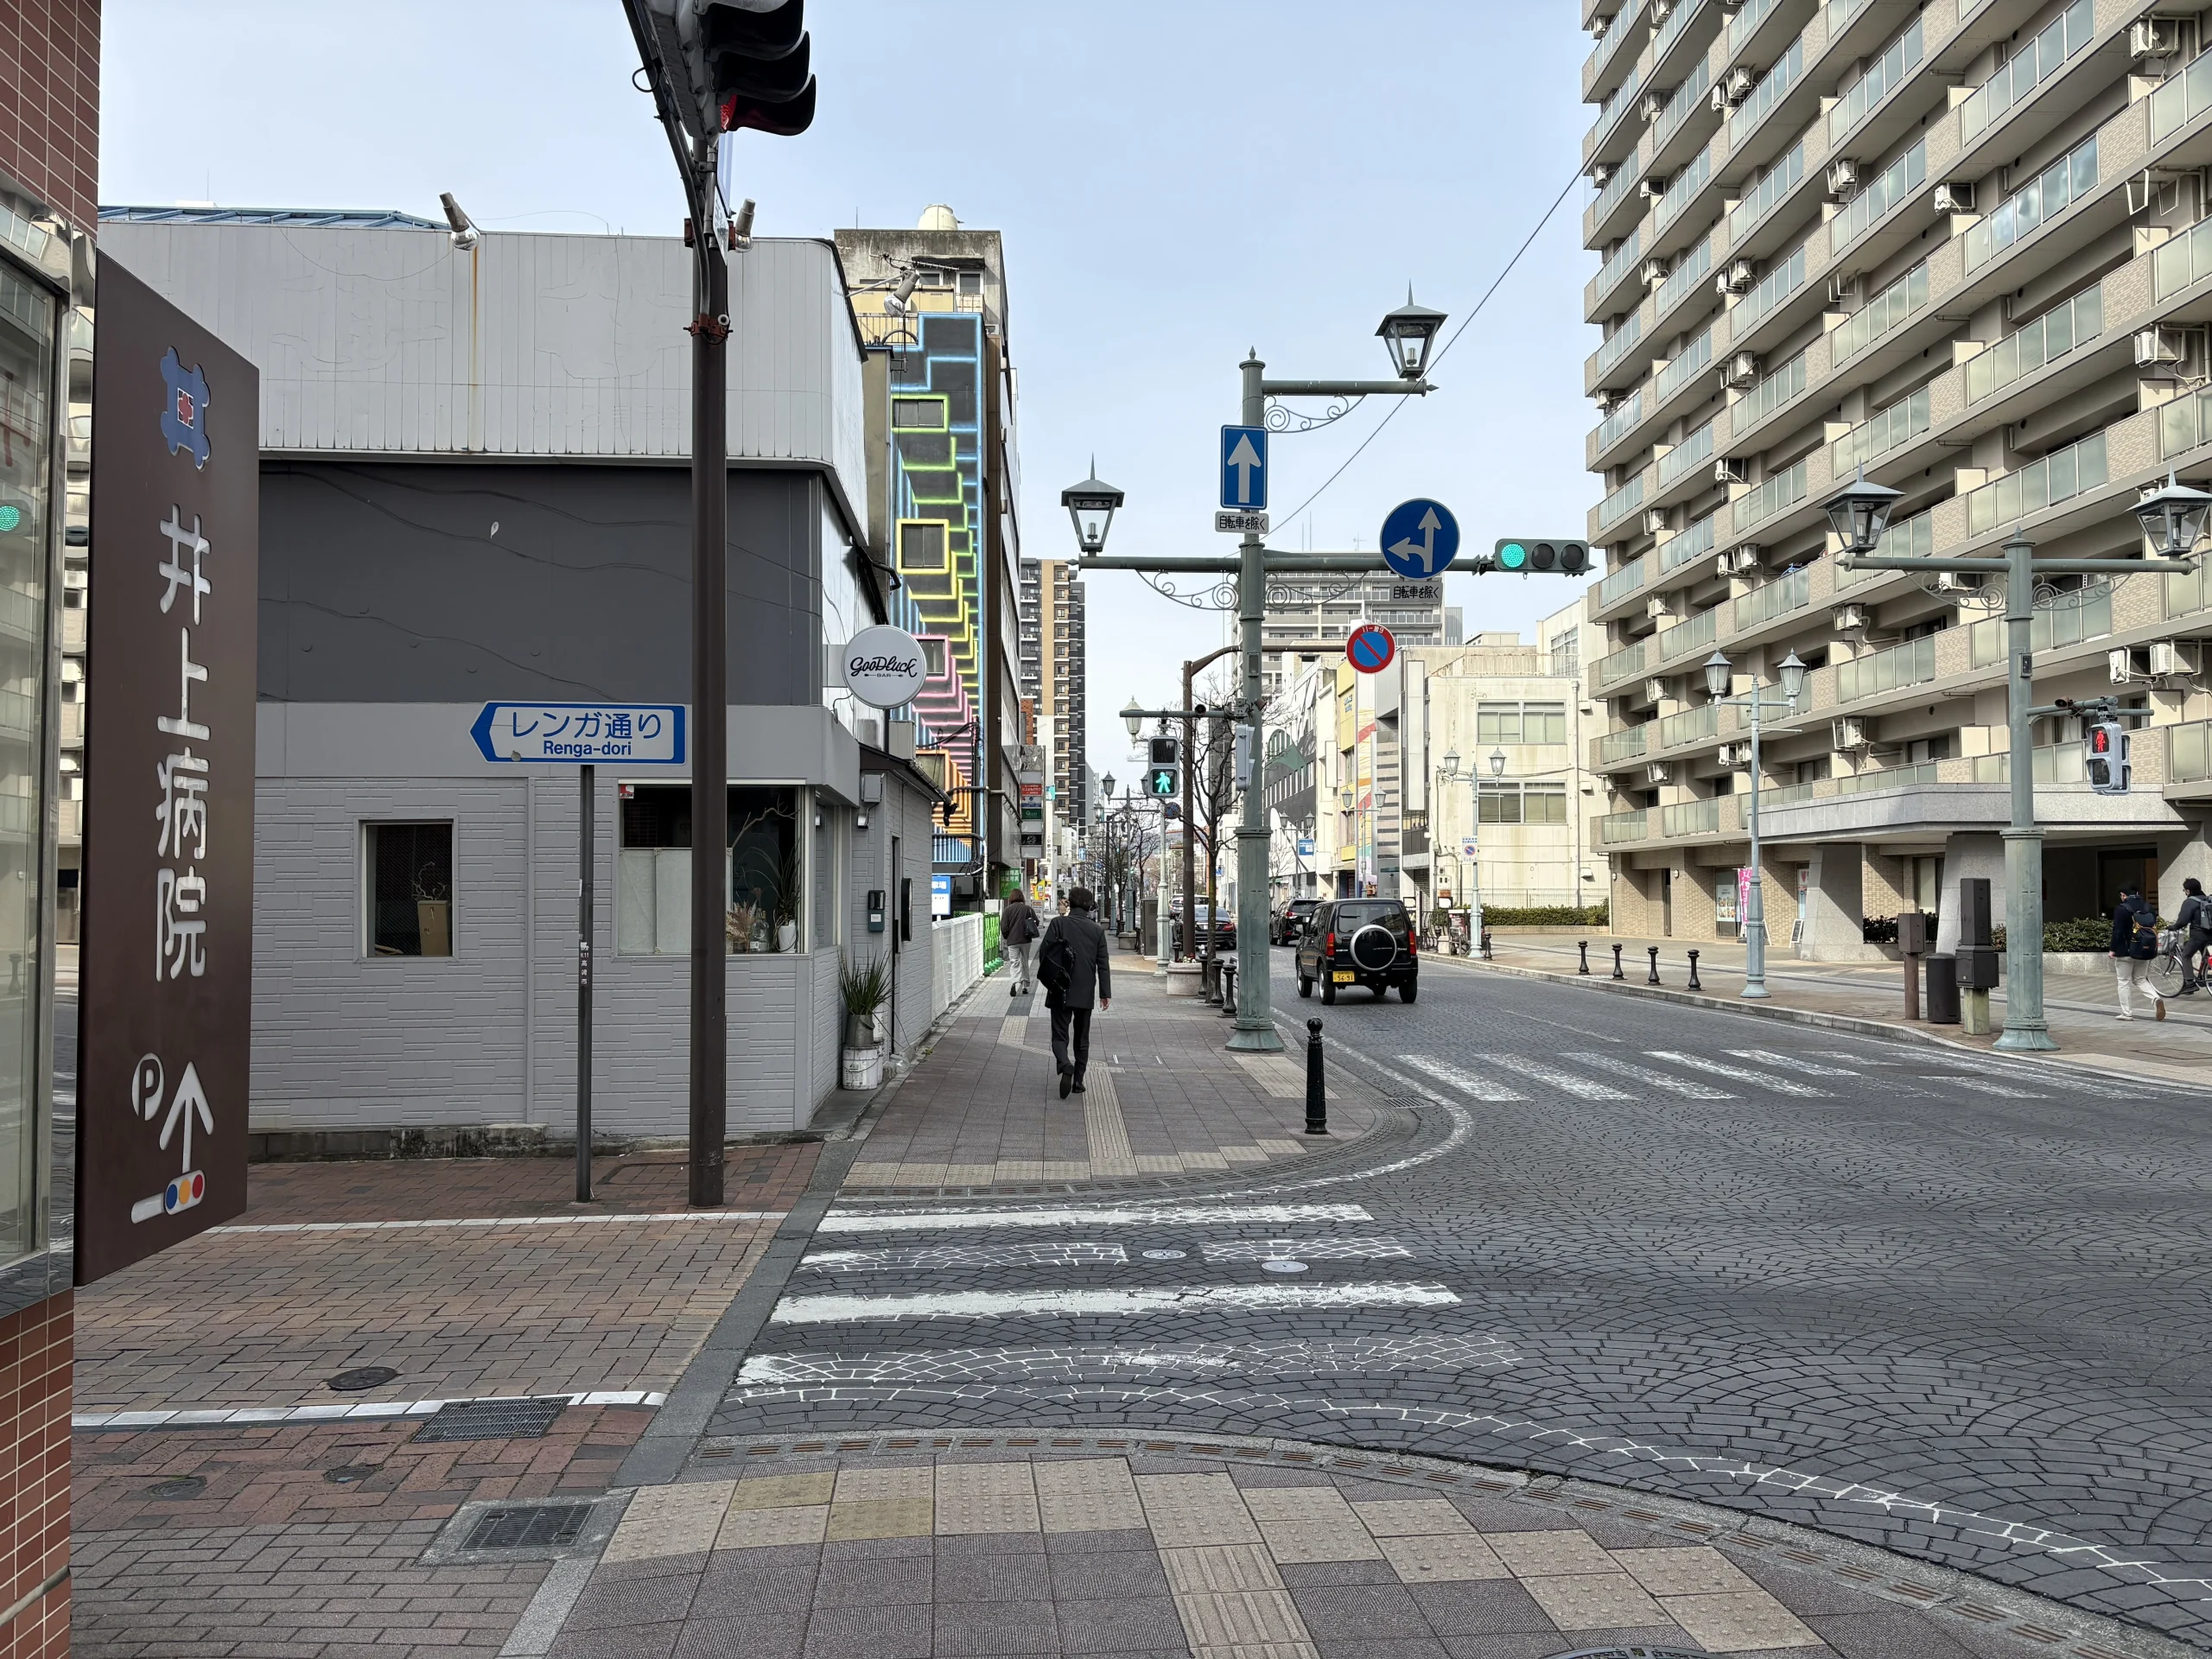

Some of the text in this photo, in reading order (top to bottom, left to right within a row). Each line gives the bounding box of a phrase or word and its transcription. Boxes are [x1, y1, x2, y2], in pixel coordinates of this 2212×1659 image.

[1219, 514, 1265, 531] 自転車を除く
[1393, 585, 1439, 599] 自転車を除く
[512, 711, 662, 740] レンガ通り
[156, 502, 213, 982] 井上病院
[543, 741, 632, 758] Renga-dori
[136, 1056, 162, 1121] P
